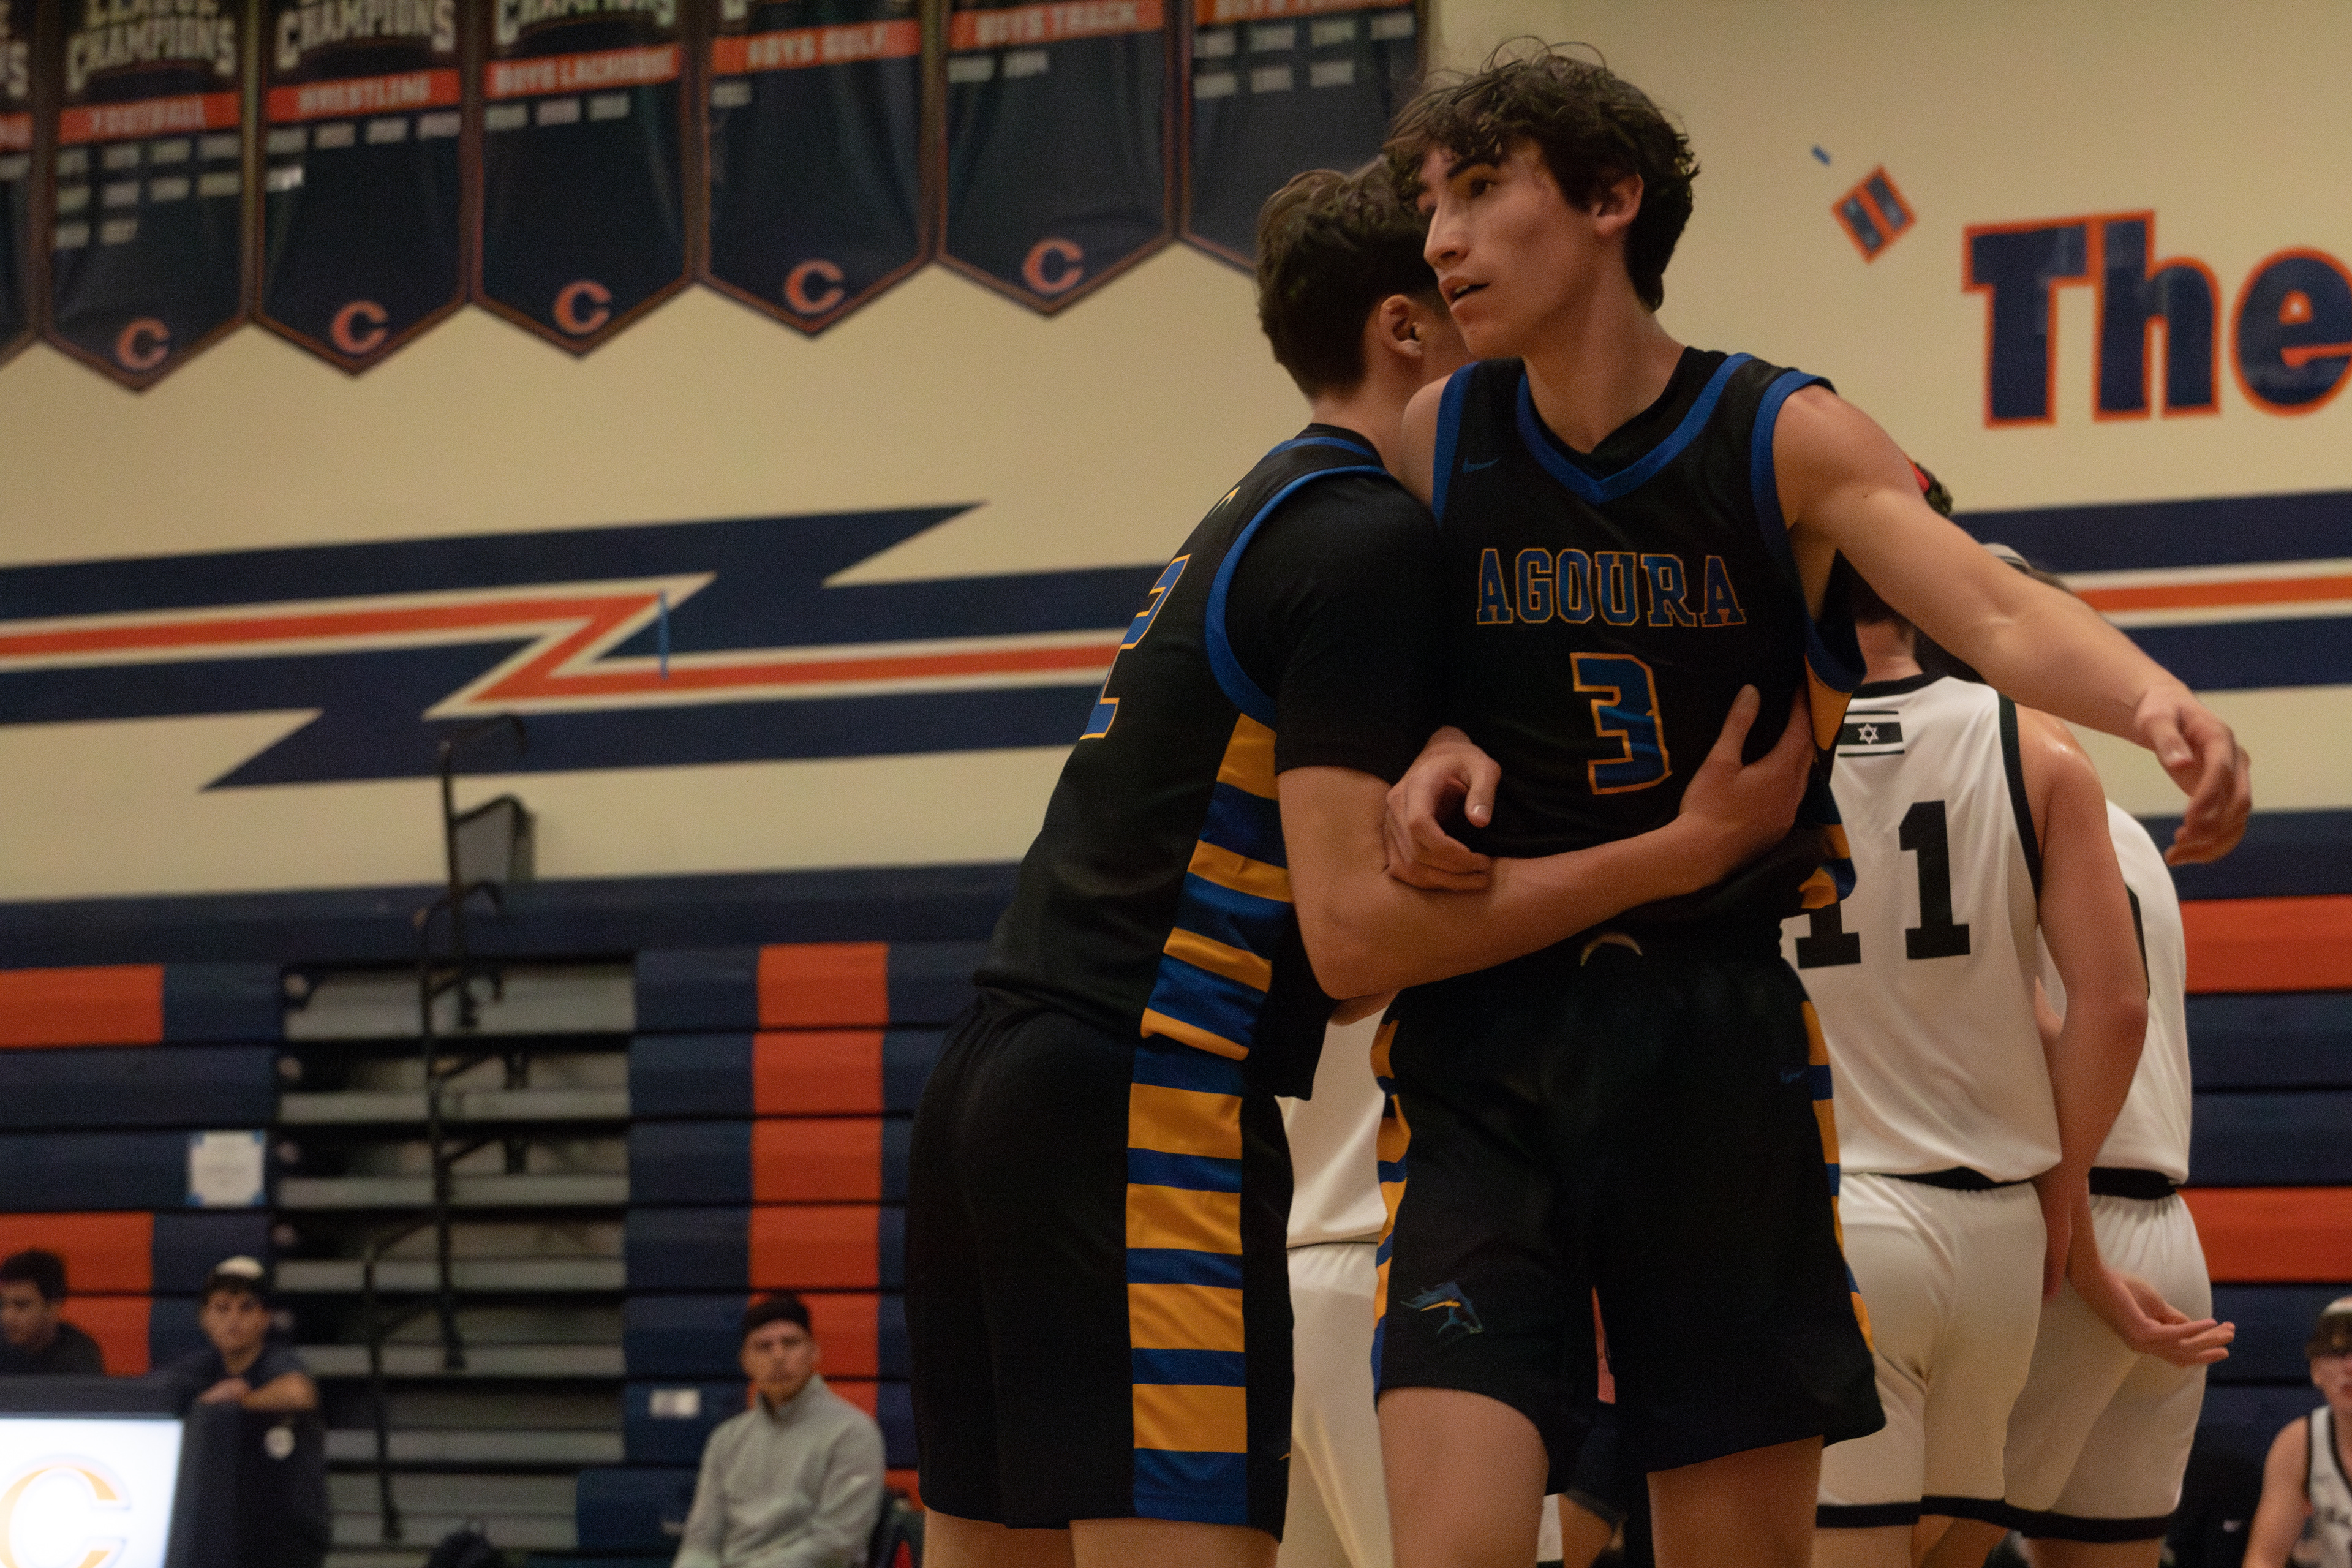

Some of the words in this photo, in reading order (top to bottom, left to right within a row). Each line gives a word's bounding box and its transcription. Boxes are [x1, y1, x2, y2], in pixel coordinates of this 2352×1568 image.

[66, 17, 236, 93] CHAMPIONS
[1962, 209, 2352, 430] The
[1476, 548, 1747, 628] AGOURA
[1569, 652, 1672, 795] 3
